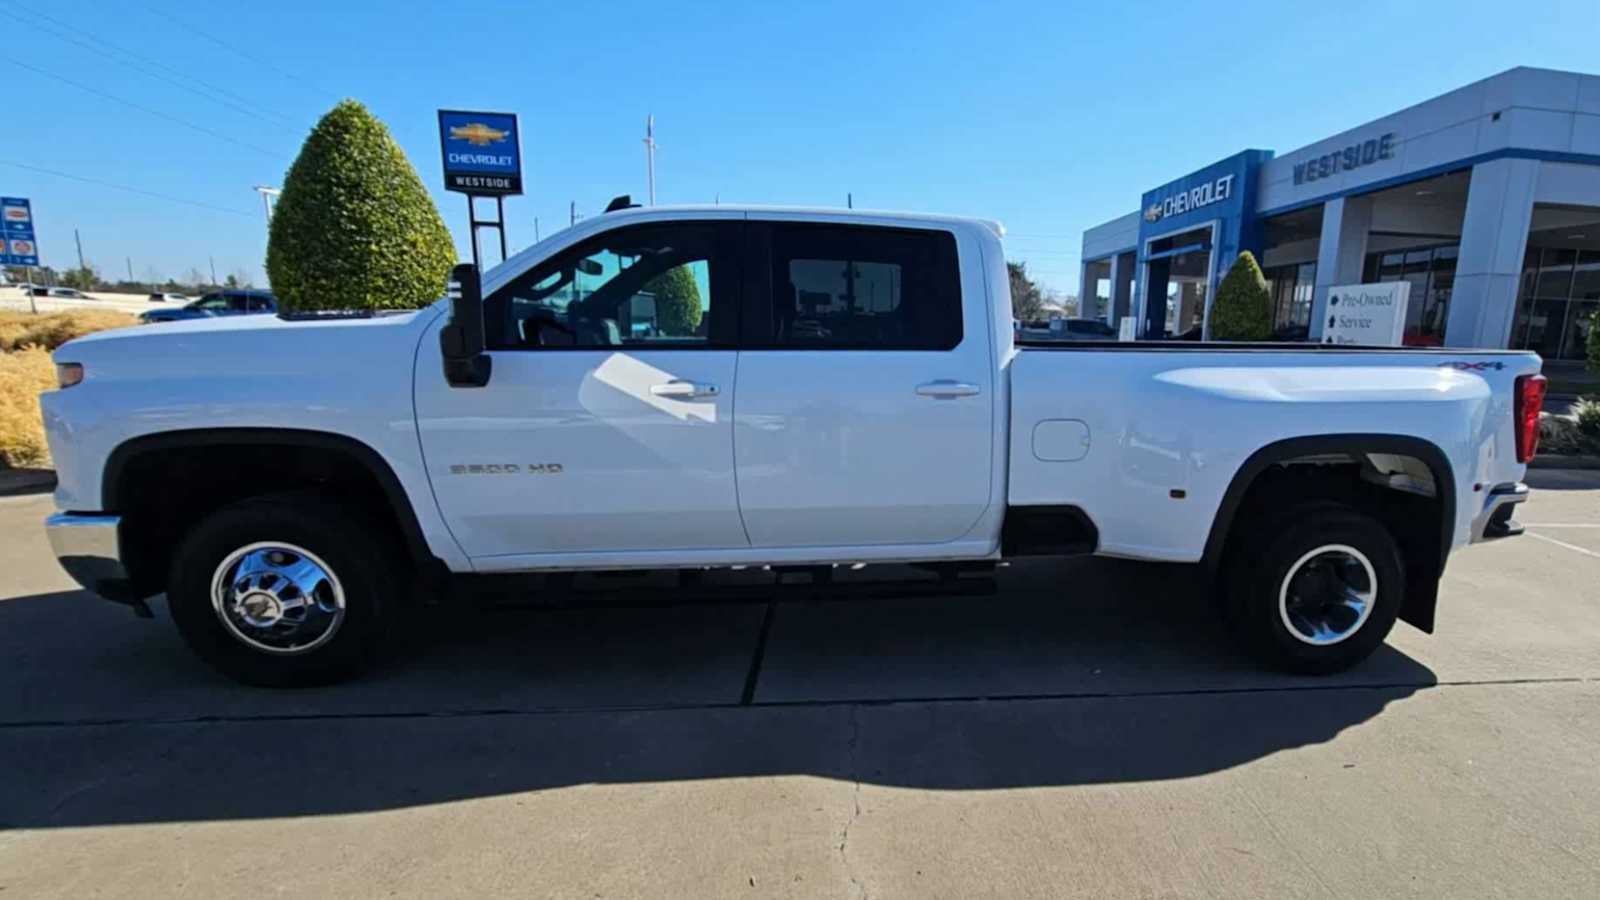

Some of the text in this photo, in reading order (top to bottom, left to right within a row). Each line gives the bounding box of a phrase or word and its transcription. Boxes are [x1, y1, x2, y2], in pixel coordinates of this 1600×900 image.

[449, 153, 512, 166] CHEVROLET
[1293, 133, 1394, 185] WESTSIDE
[456, 177, 511, 188] WESTSIDE
[1163, 173, 1234, 217] CHEVROLET
[1342, 291, 1393, 307] Pre-Owned
[1339, 315, 1372, 328] Service
[528, 463, 562, 474] HD
